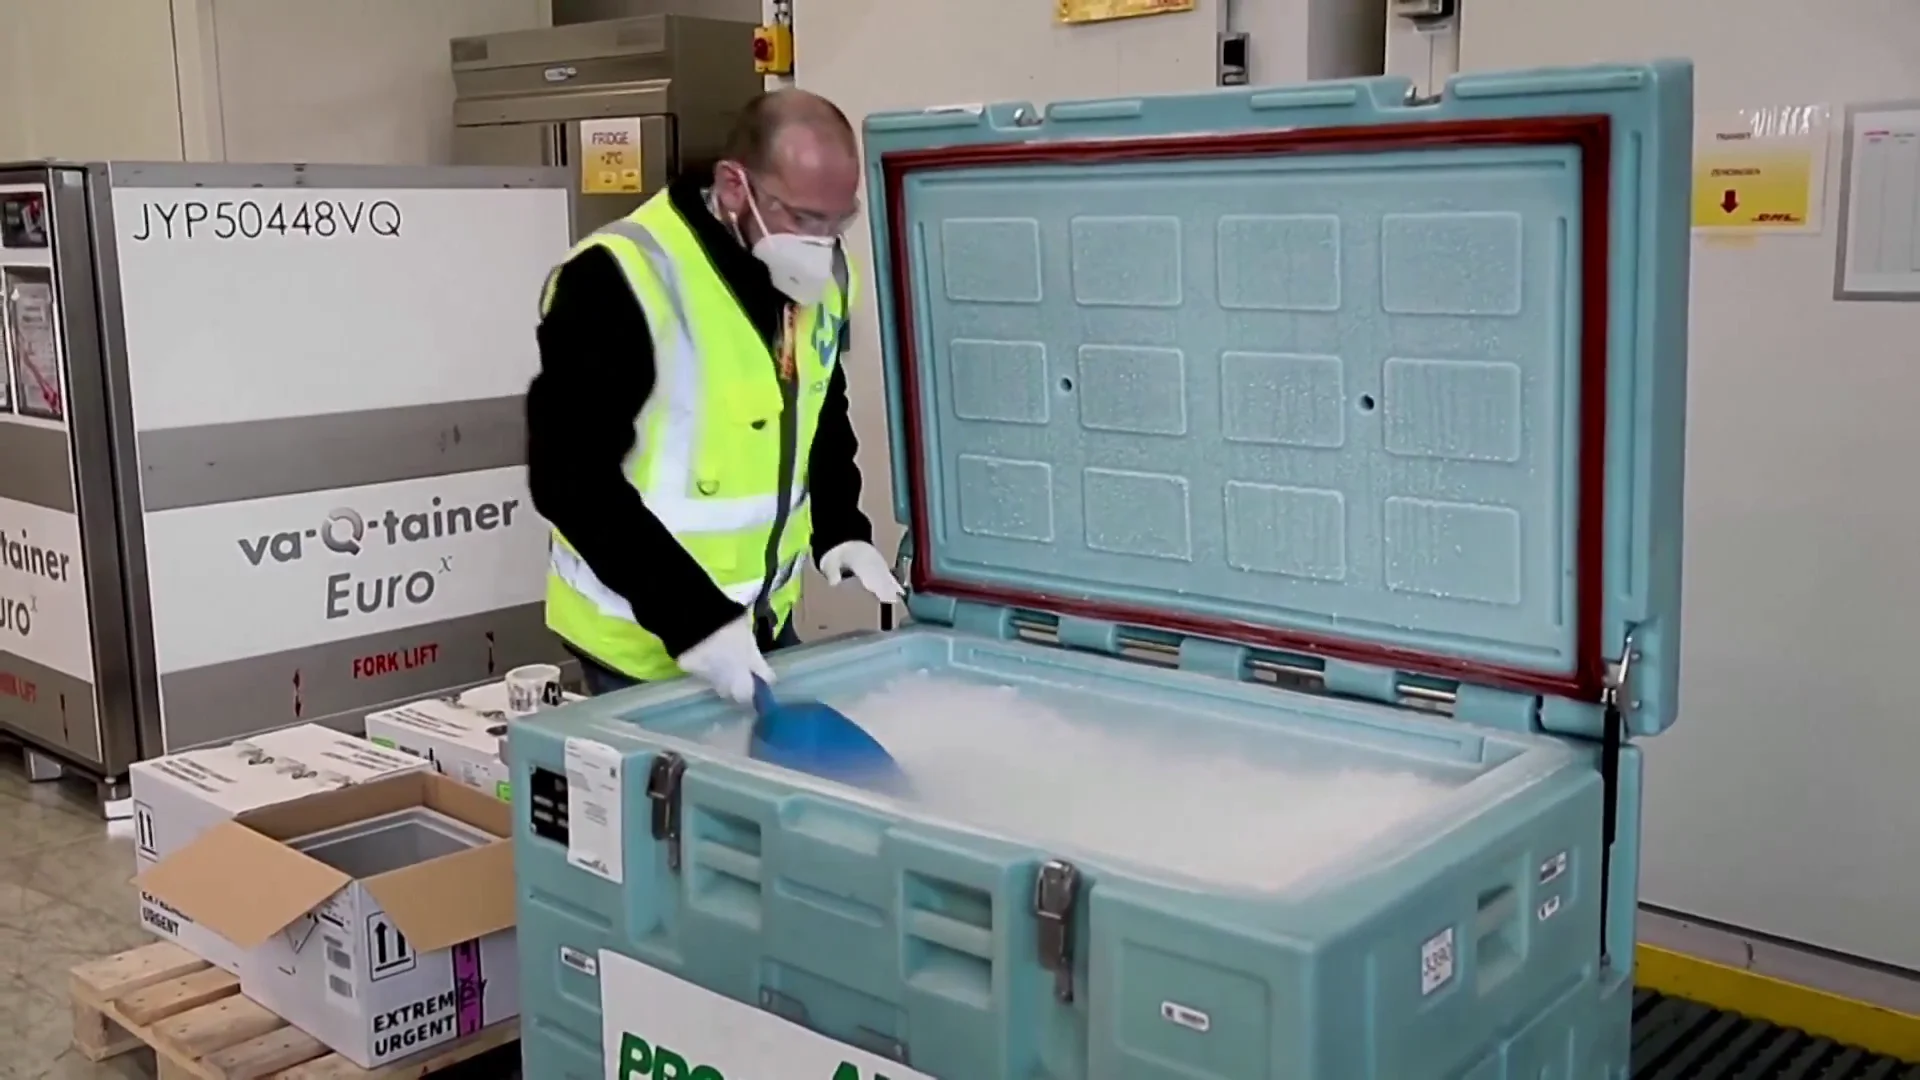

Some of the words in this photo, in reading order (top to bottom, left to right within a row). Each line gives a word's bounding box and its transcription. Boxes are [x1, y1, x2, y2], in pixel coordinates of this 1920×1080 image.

[133, 200, 401, 241] JYP50448VQ
[237, 496, 519, 566] va-Q-tainer
[353, 653, 400, 679] FORK
[404, 644, 438, 669] LIFT
[374, 1014, 455, 1057] URGENT
